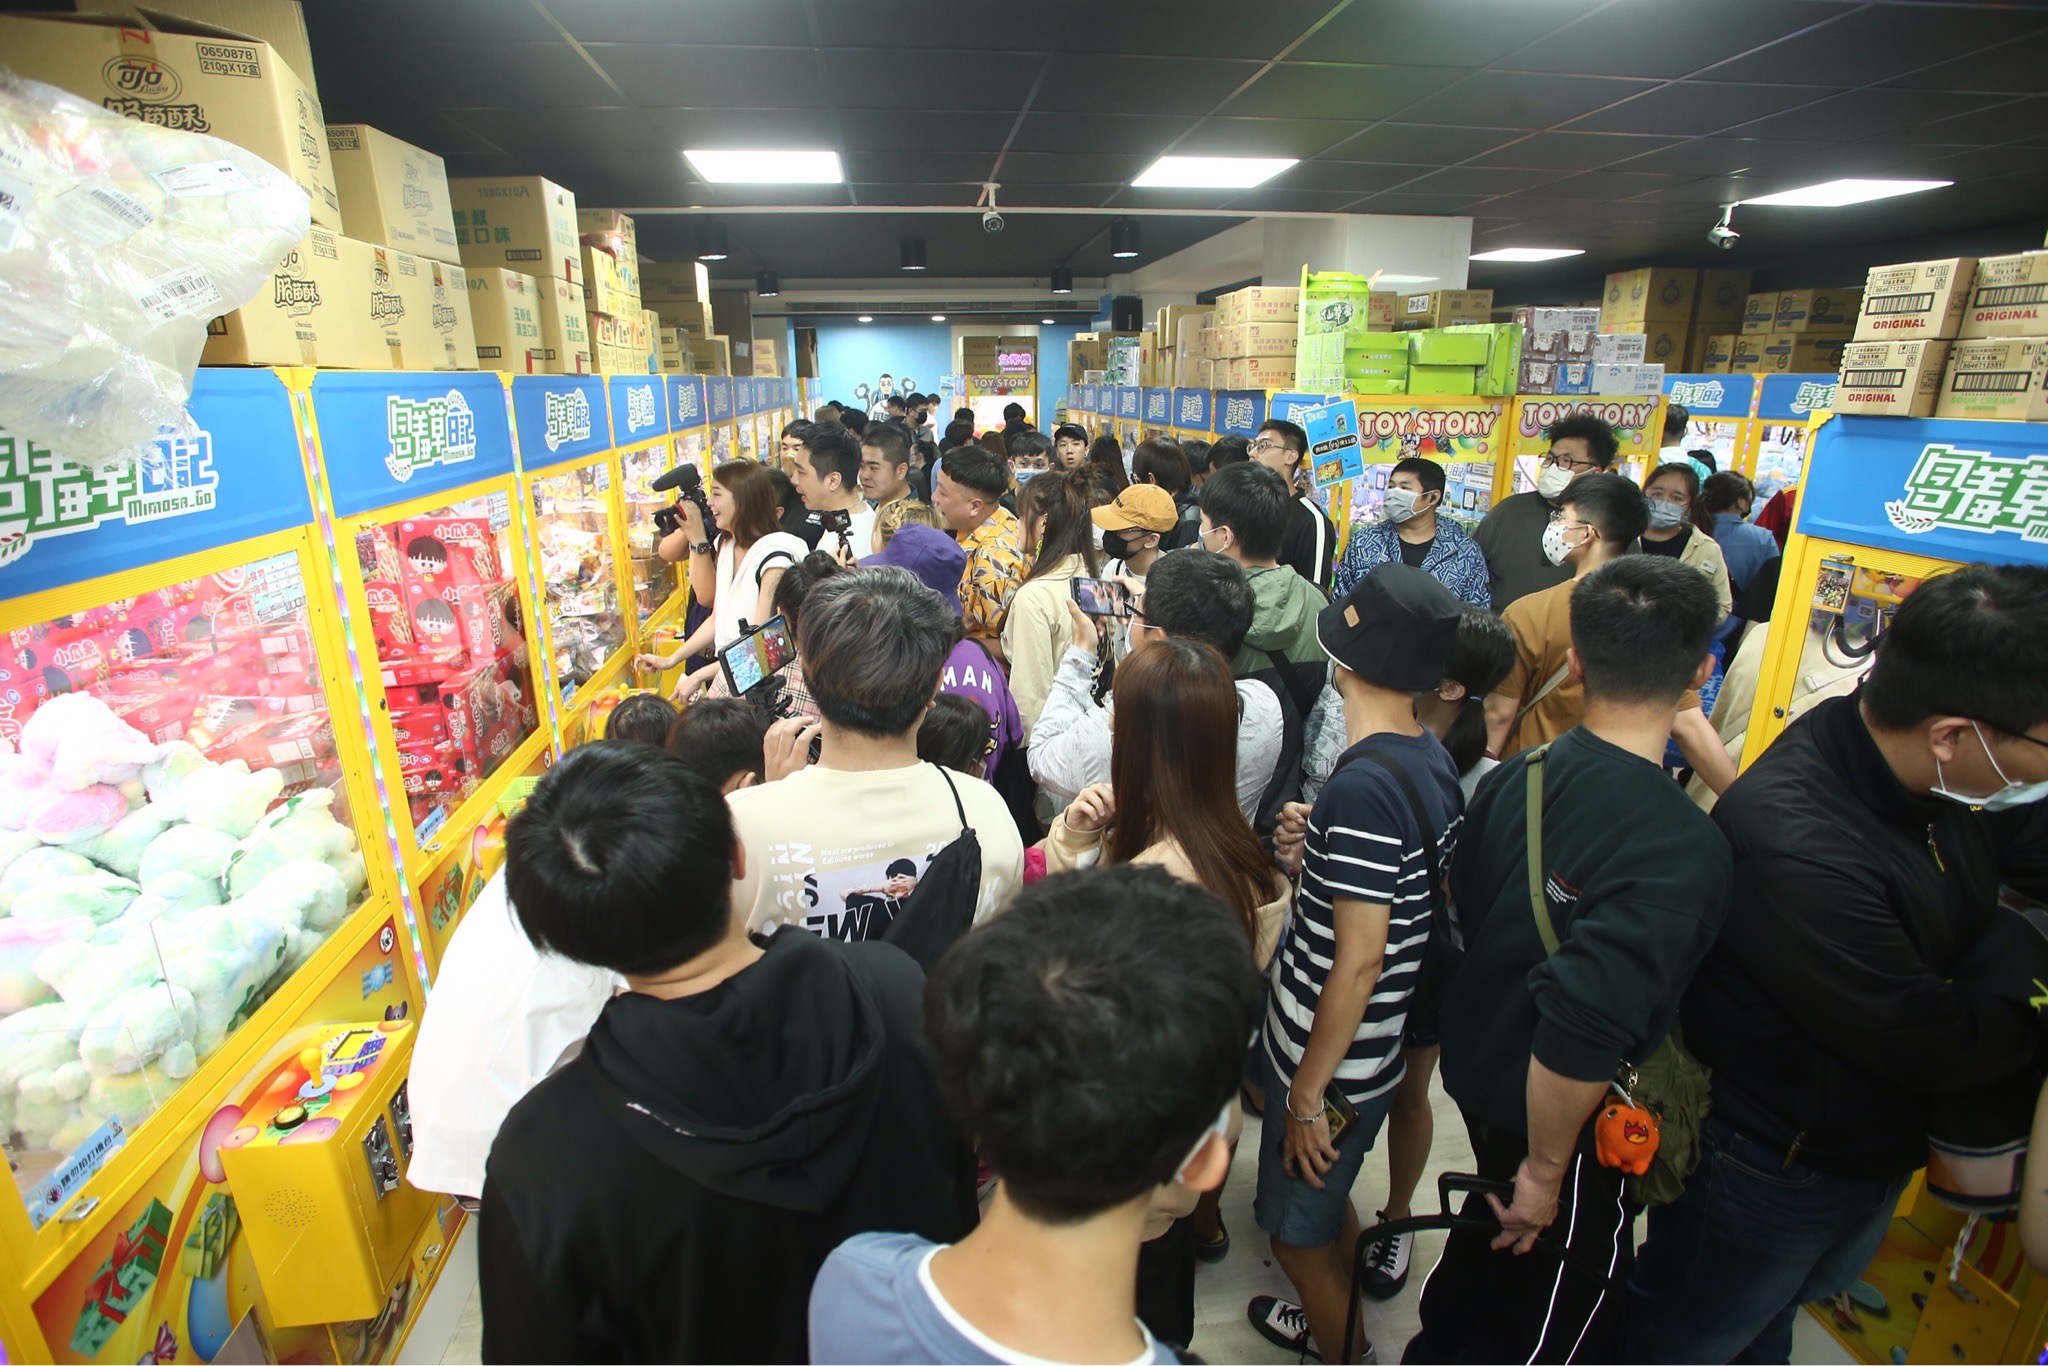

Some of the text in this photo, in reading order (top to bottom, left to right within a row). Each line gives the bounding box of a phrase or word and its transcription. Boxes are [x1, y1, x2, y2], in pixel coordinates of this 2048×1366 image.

[201, 46, 253, 60] 0650878
[203, 61, 259, 76] 210gX12盒
[275, 274, 321, 307] 脆笛酥
[1976, 310, 2039, 322] ORIGINAL
[1873, 319, 1926, 330] ORIGINAL
[974, 379, 1030, 387] TOY STORY
[1848, 393, 1896, 402] ORIGINAL
[1523, 402, 1573, 429] TOY
[1359, 411, 1413, 439] TOY
[1416, 410, 1496, 439] STORY
[941, 665, 993, 694] MAN
[820, 848, 840, 857] Most
[841, 846, 852, 854] are
[854, 841, 887, 853] produced
[822, 852, 874, 865] Editions works
